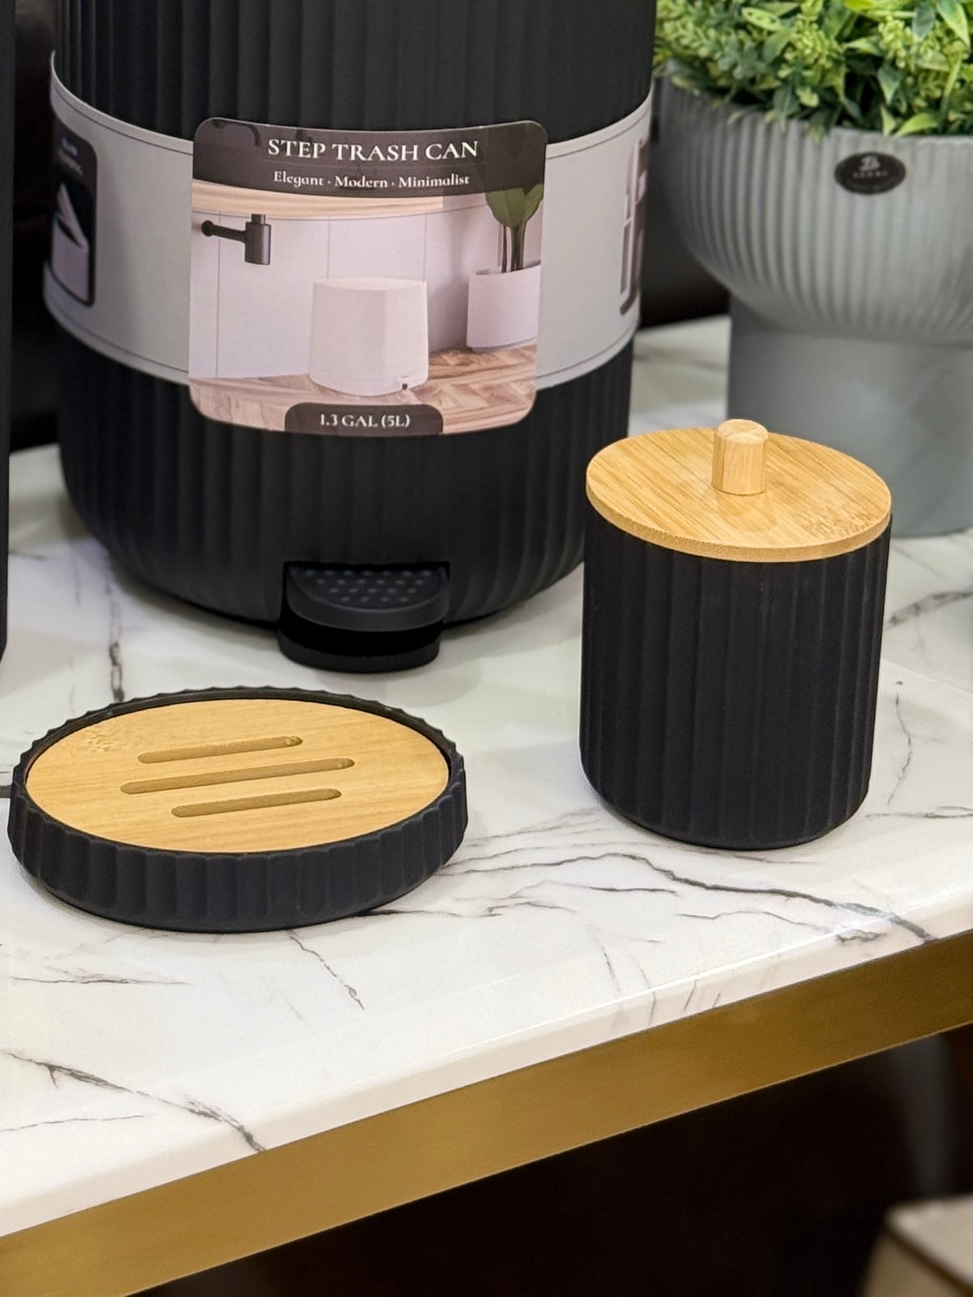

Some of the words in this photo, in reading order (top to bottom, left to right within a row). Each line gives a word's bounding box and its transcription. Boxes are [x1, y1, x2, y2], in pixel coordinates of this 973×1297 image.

[267, 138, 326, 159] STEP
[331, 143, 419, 161] TRASH
[425, 140, 479, 160] CAN
[273, 171, 324, 188] Elegant
[334, 175, 388, 188] Modern
[398, 173, 470, 188] Minimalist
[320, 413, 339, 426] 1.3
[341, 414, 378, 428] GAL
[381, 414, 411, 428] (5L)
